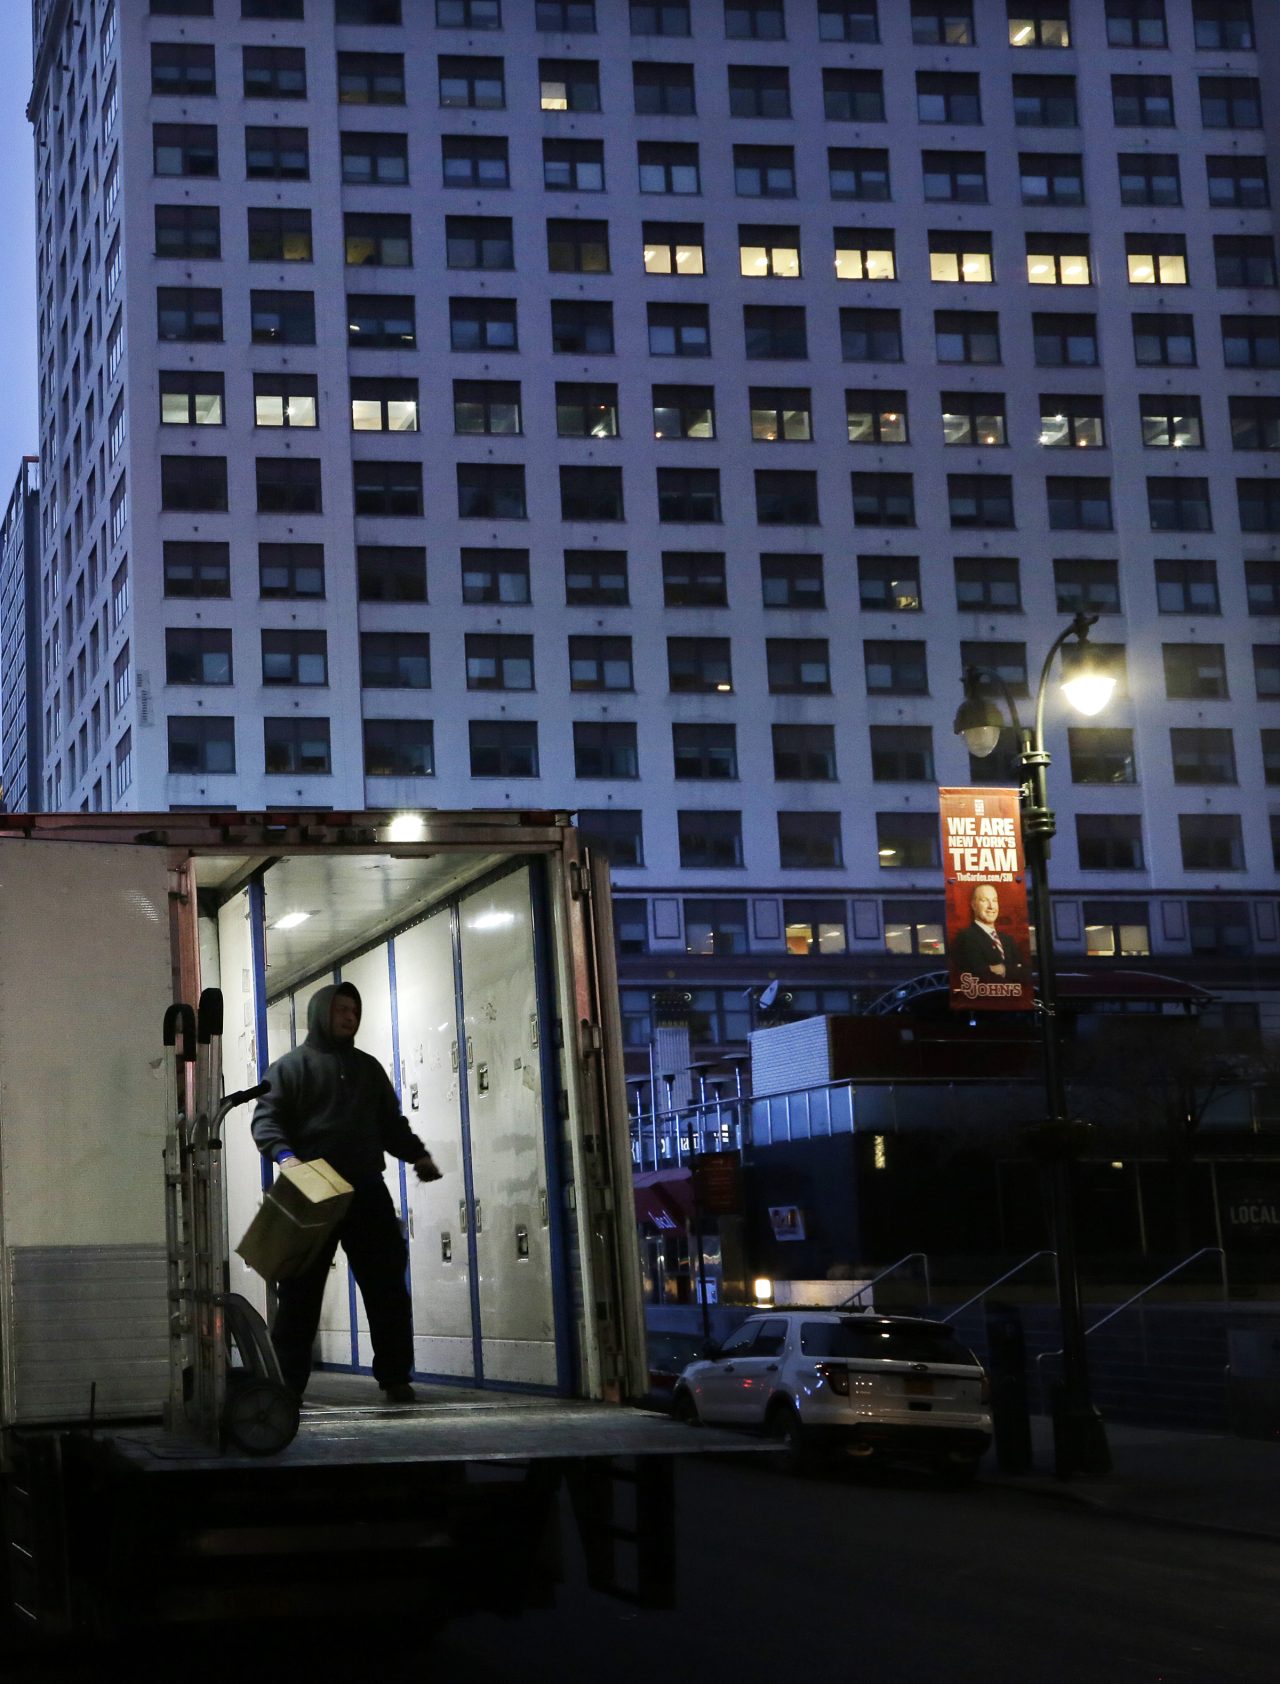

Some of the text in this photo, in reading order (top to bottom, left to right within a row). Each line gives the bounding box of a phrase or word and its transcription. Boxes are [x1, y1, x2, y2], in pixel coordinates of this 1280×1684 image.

[947, 817, 1015, 836] WE ARE
[948, 836, 1016, 848] NEW YORK'S
[950, 848, 1018, 872] TEAM
[1230, 1206, 1280, 1224] LOCAL
